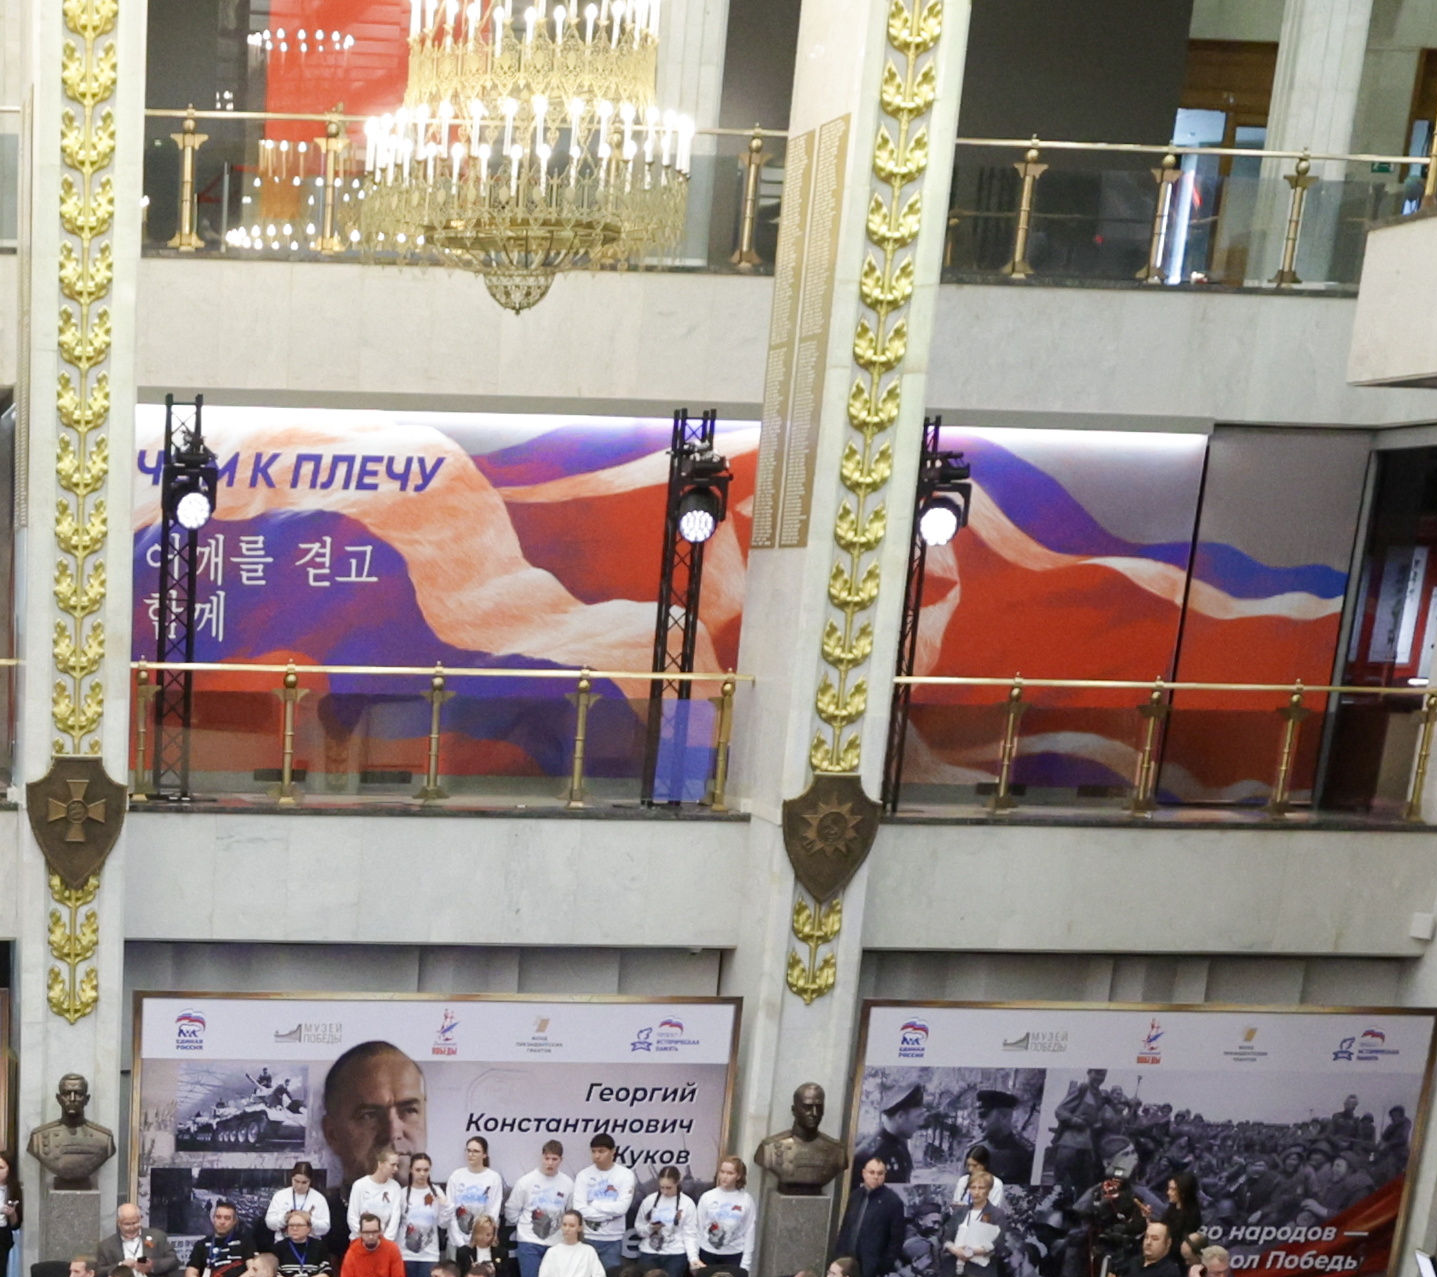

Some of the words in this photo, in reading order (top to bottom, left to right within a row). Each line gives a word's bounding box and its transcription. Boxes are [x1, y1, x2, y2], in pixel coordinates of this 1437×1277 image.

[248, 454, 280, 487] К
[290, 454, 445, 492] ПЛЕЧУ
[304, 1022, 342, 1032] МУЗЕЙ
[304, 1034, 342, 1044] ПОБЕДЫ
[1031, 1033, 1068, 1042] МУЗЕЙ
[585, 1082, 698, 1106] Георгий
[465, 1113, 694, 1134] Константинович
[1228, 1225, 1337, 1245] народов
